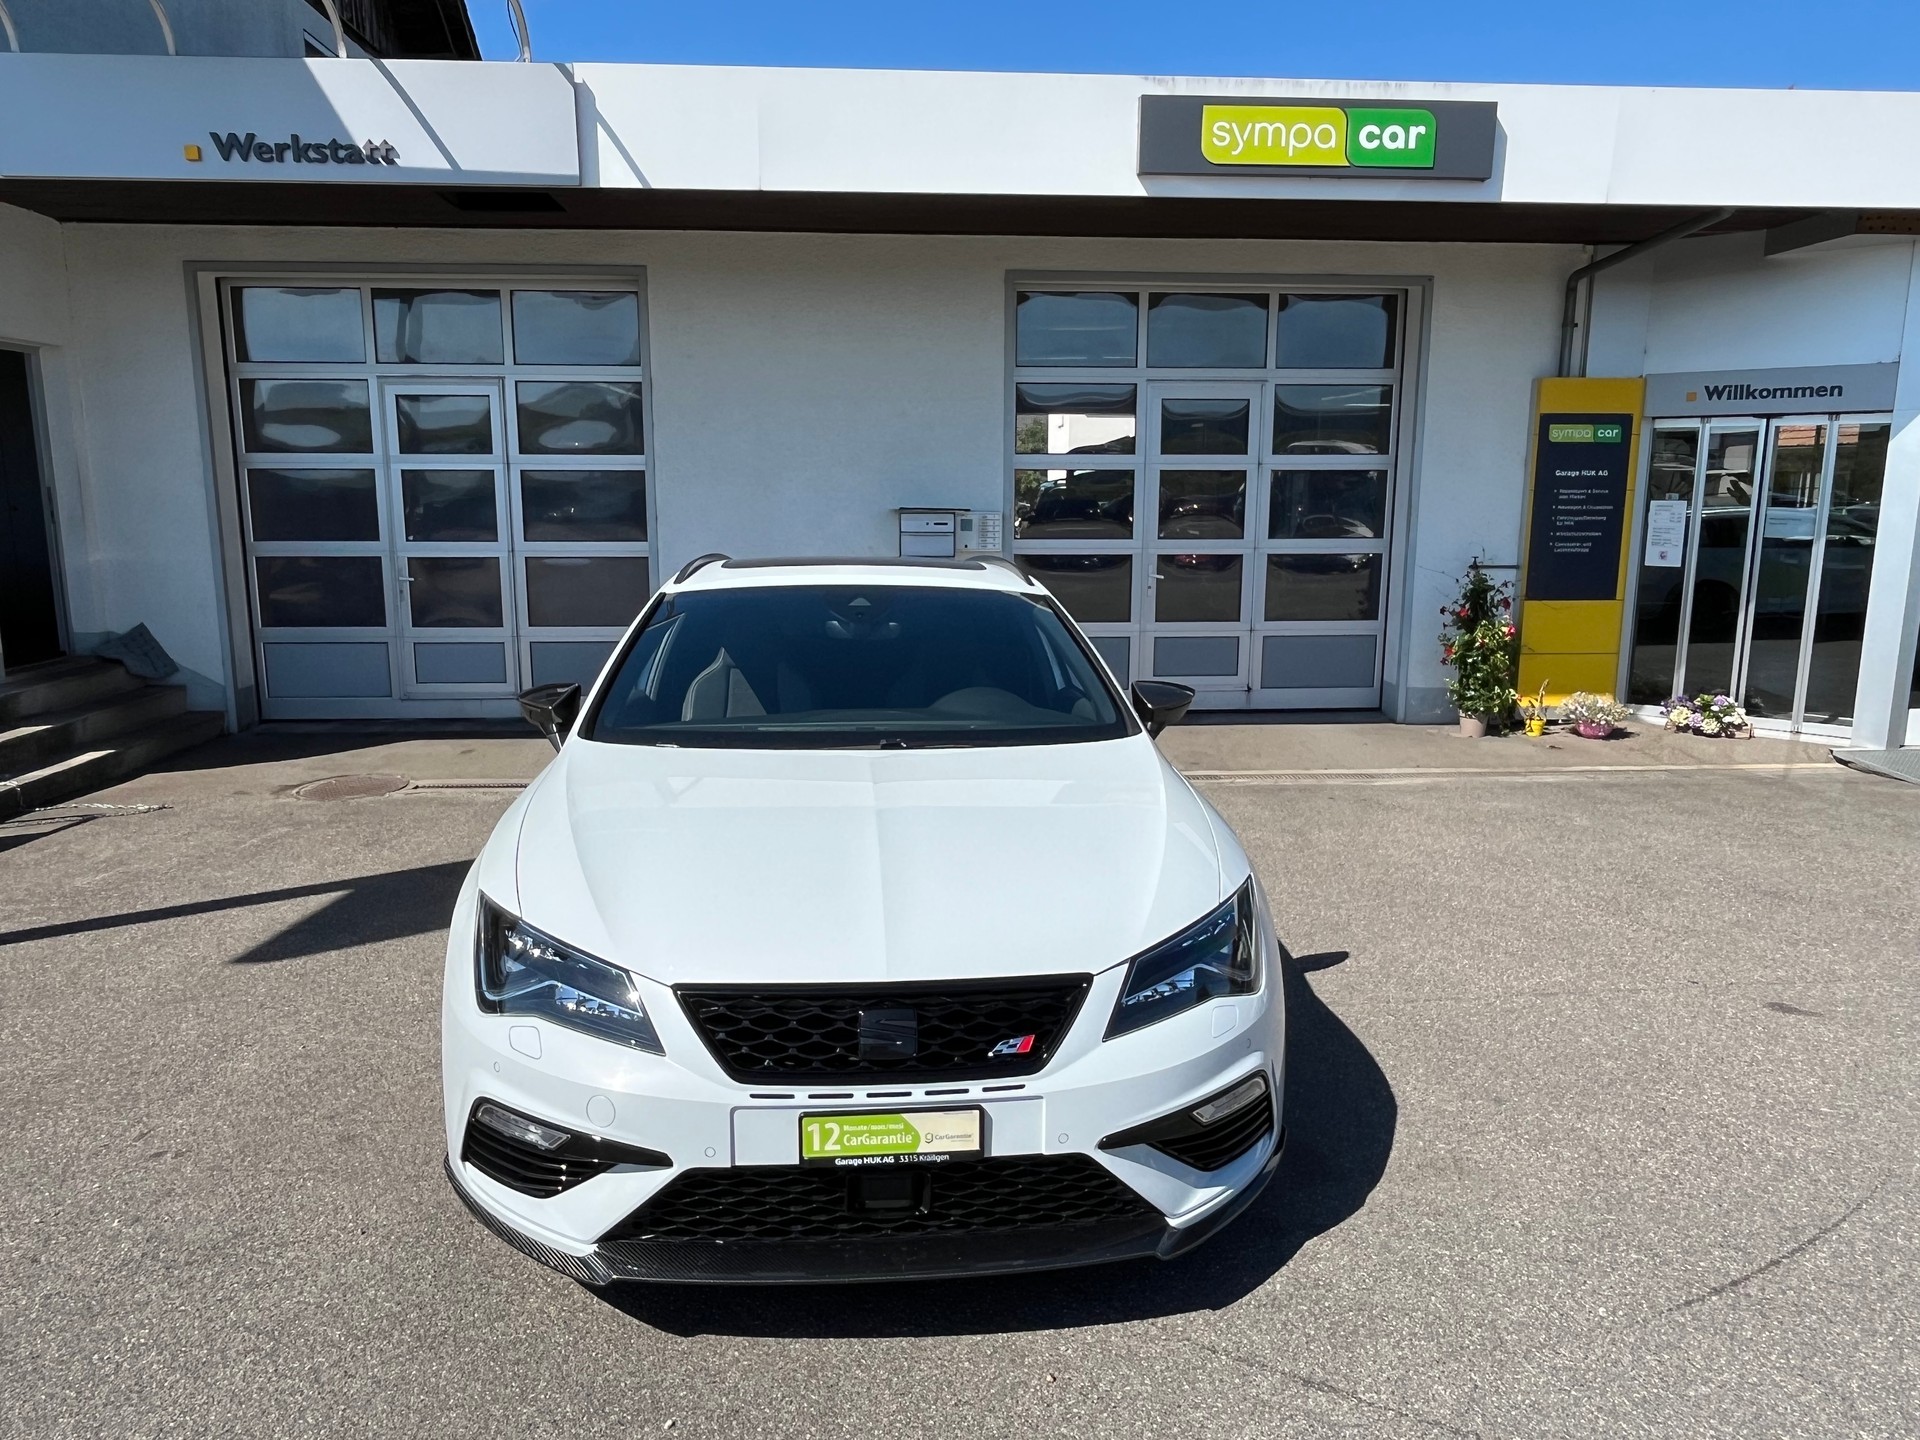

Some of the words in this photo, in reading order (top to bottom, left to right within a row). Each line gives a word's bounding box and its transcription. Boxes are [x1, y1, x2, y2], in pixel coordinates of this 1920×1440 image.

[209, 131, 400, 164] Werkstatt
[1212, 121, 1336, 157] sympa
[1358, 124, 1426, 150] car
[1704, 384, 1844, 401] Willkommen
[1551, 429, 1591, 440] sympa
[1597, 429, 1619, 437] car
[1555, 469, 1580, 477] Garage
[807, 1122, 841, 1151] 12
[835, 1157, 862, 1167] Garage
[863, 1156, 882, 1164] HUK
[898, 1154, 918, 1163] 3315
